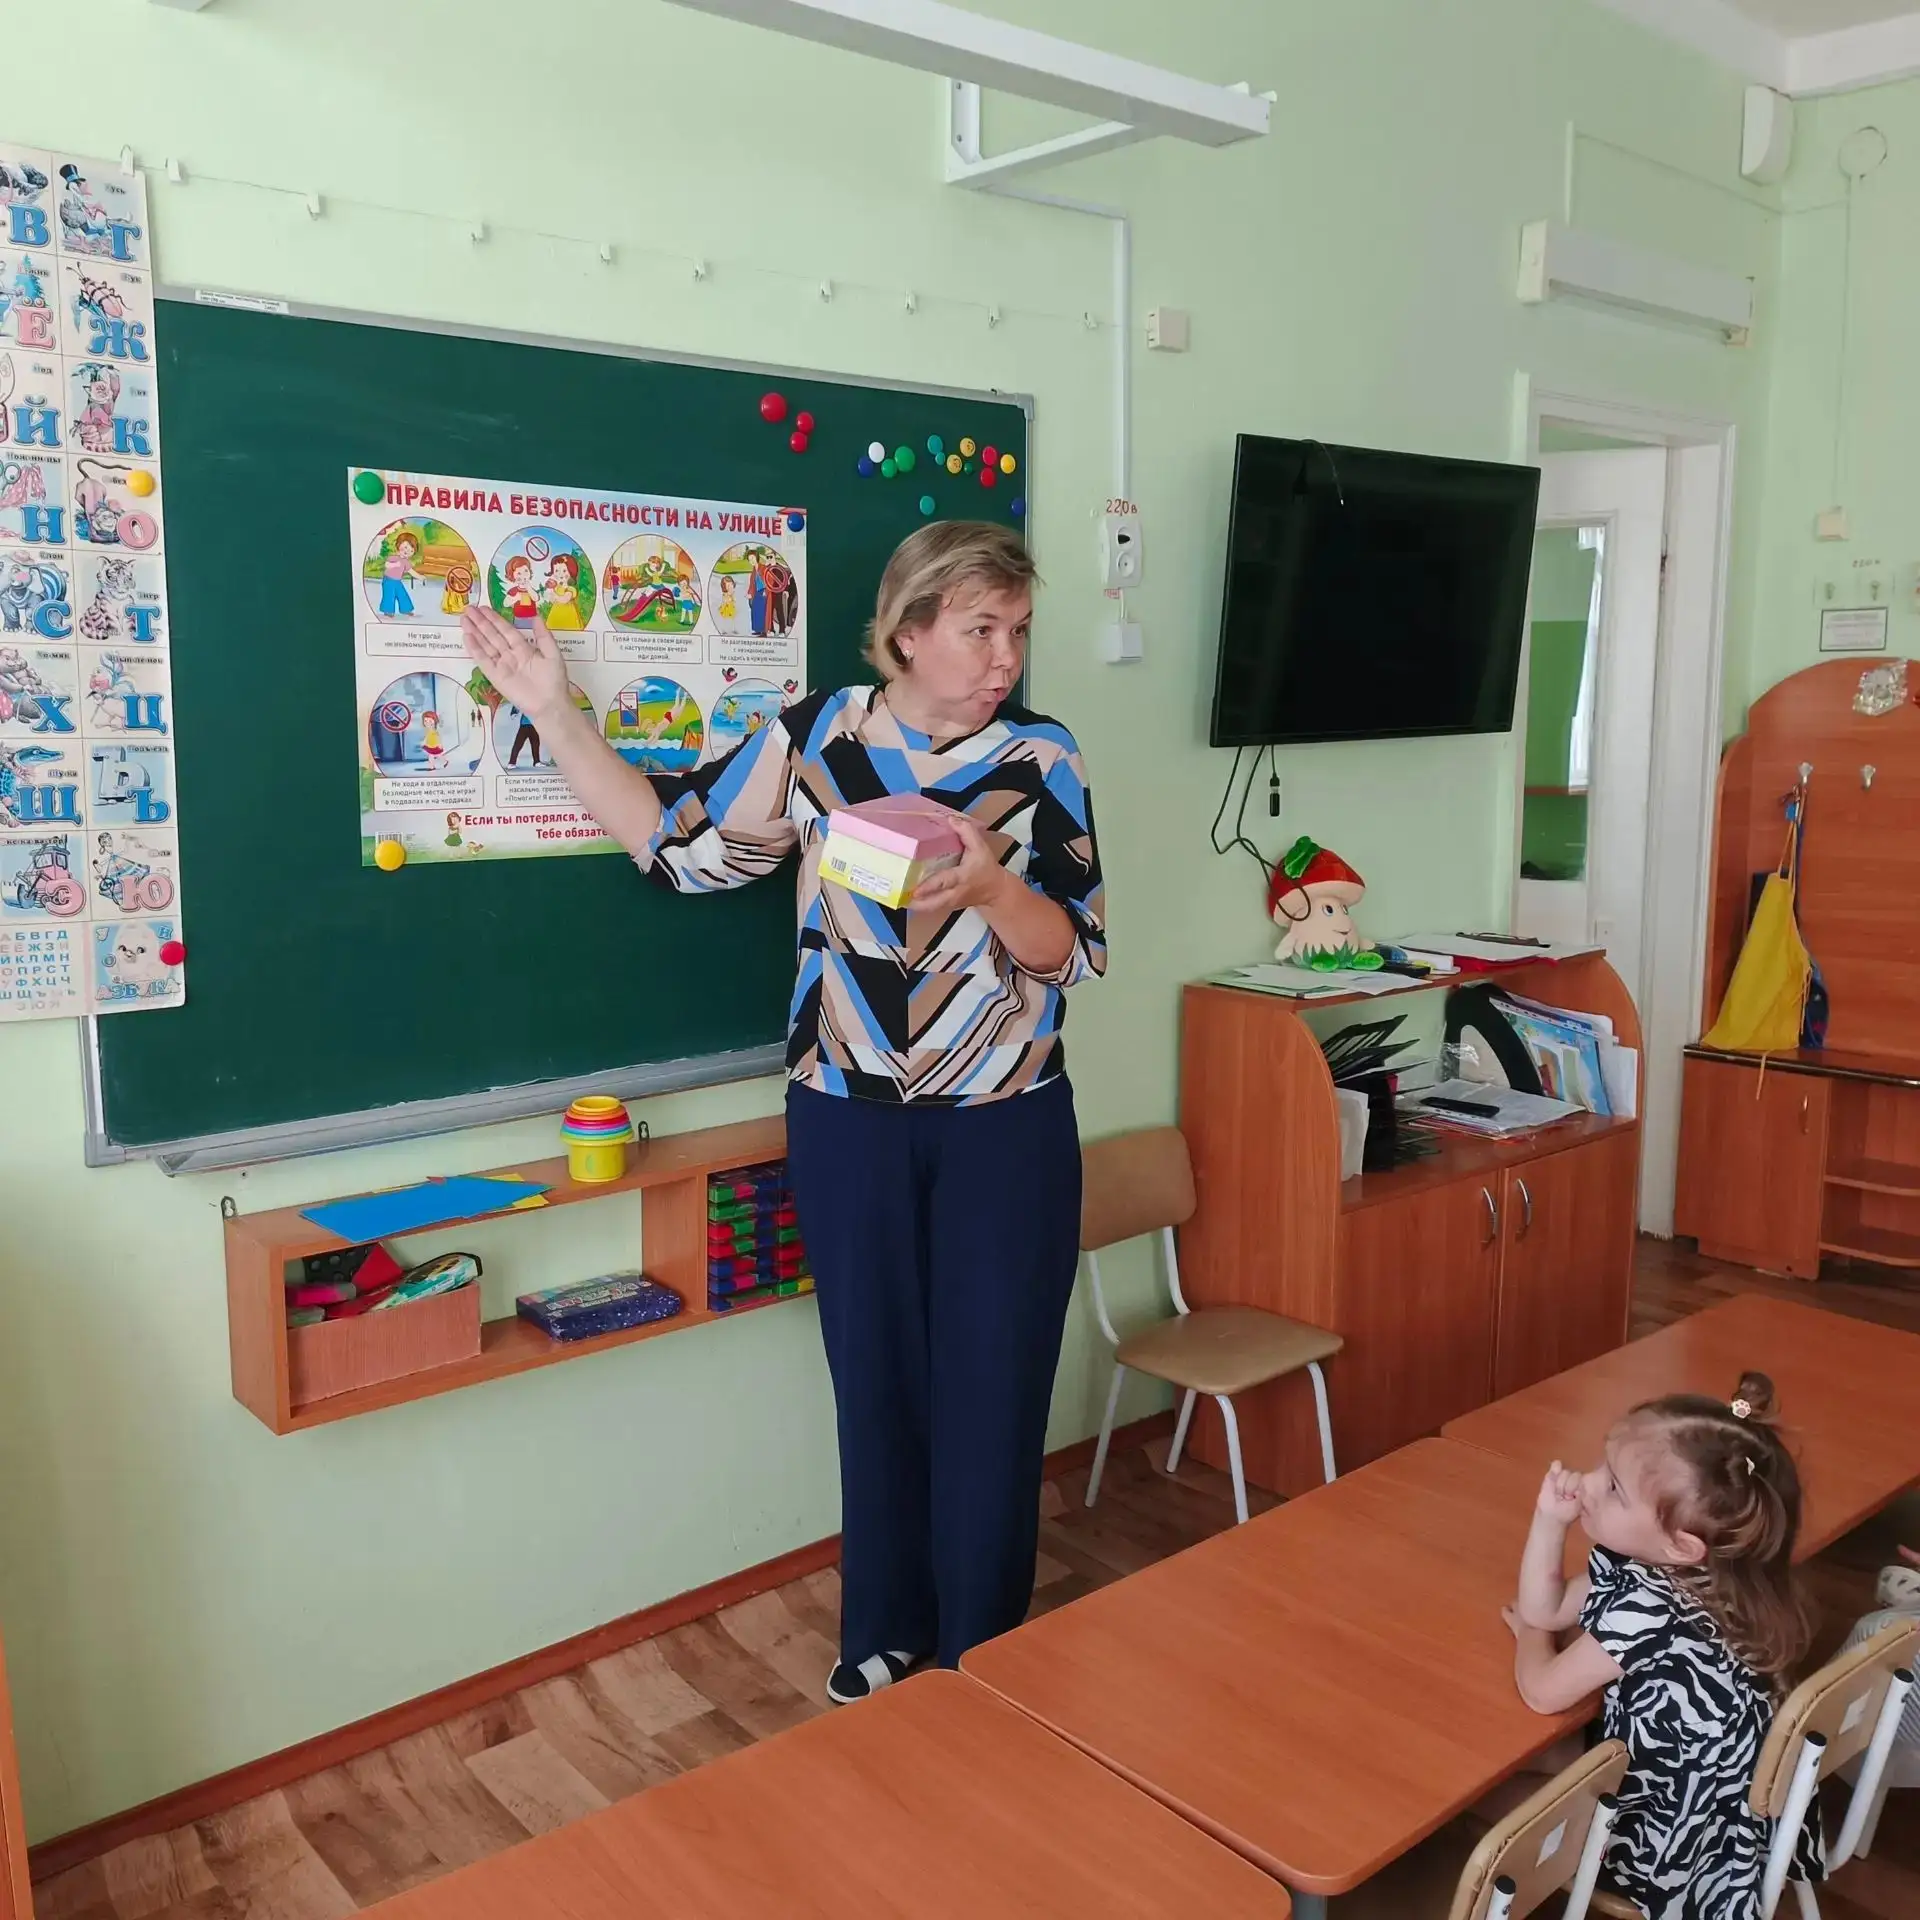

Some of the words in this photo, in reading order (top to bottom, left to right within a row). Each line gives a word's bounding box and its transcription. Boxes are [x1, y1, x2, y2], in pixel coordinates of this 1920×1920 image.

[7, 203, 51, 248] В
[110, 222, 142, 262] Г
[14, 304, 55, 351] Е
[87, 317, 151, 362] Ж
[13, 395, 63, 448] Й
[111, 415, 153, 457] К
[20, 502, 66, 545] Н
[116, 508, 160, 550] О
[387, 483, 503, 514] ПРАВИЛА
[510, 493, 679, 528] БЕЗОПАСНОСТИ
[686, 509, 713, 531] НА
[718, 511, 783, 539] УЛИЦЕ
[32, 599, 74, 641] С
[125, 604, 163, 644] Т
[30, 693, 77, 734] Х
[121, 693, 169, 736] Ц
[16, 783, 84, 828] Щ
[126, 786, 172, 824] Ъ
[465, 814, 494, 826] Если
[496, 814, 512, 825] ты
[515, 811, 578, 827] потерялся,
[536, 828, 562, 840] Тебе
[44, 878, 87, 917] Э
[118, 873, 175, 913] Ю
